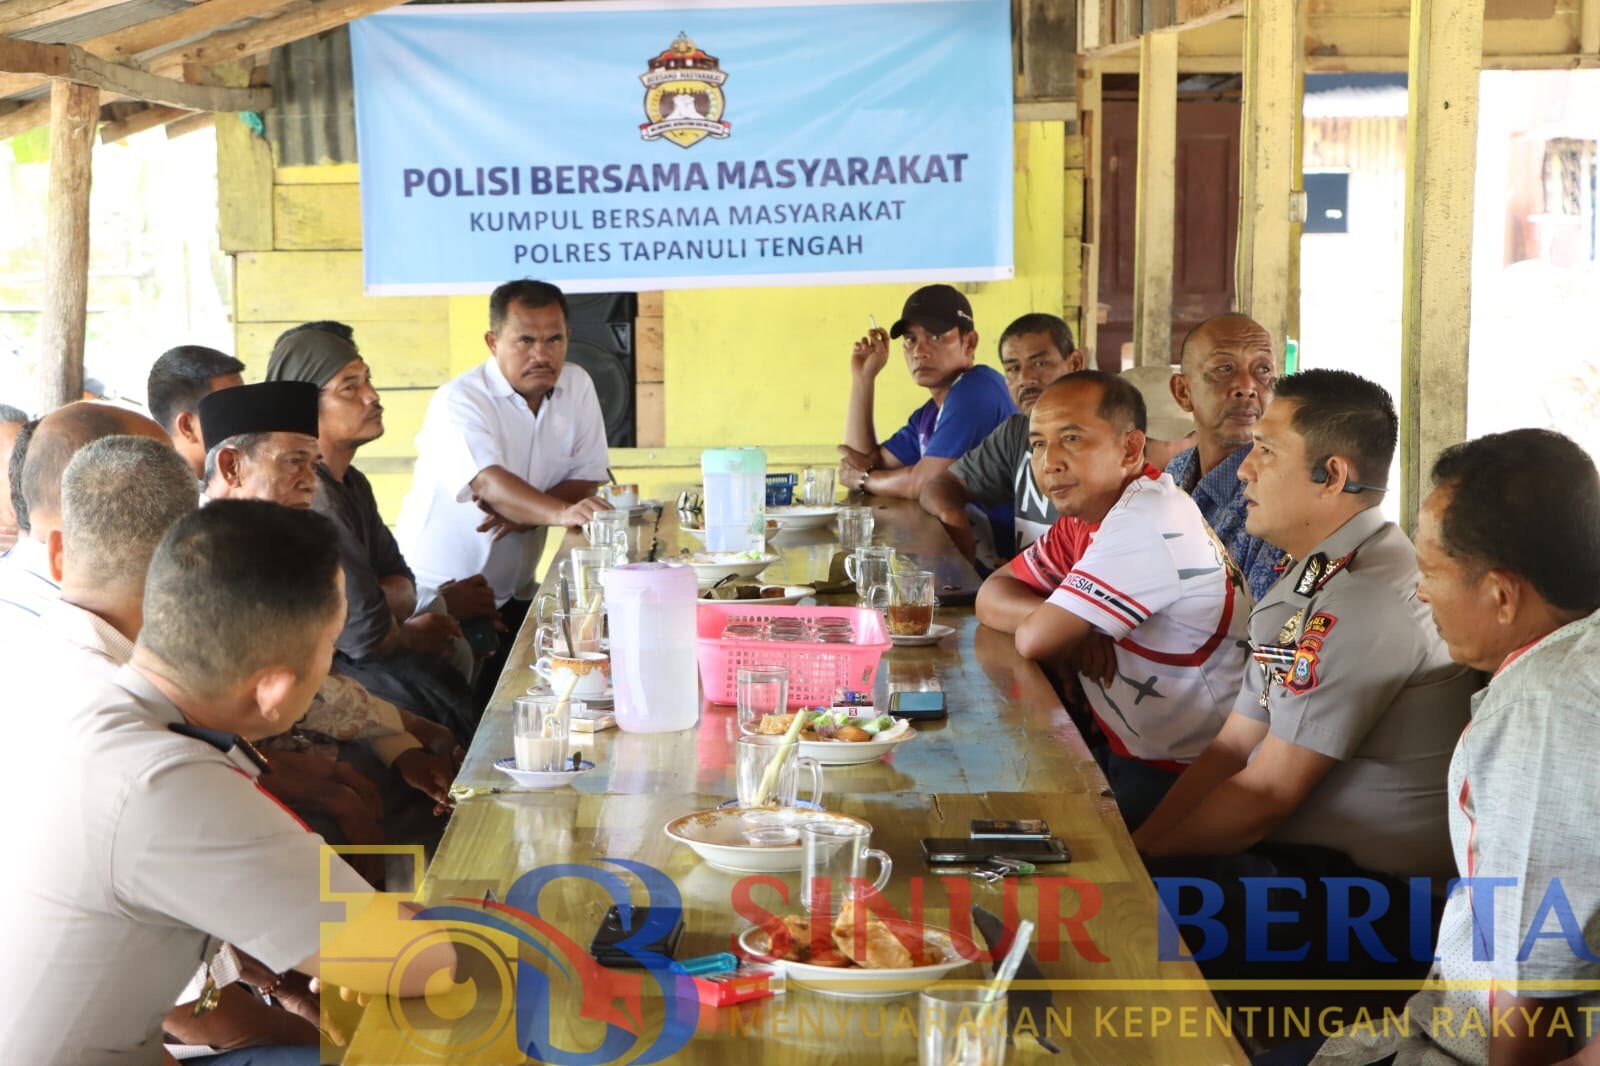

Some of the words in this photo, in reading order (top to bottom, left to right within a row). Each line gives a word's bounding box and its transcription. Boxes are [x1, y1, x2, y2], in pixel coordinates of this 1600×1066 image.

[404, 167, 520, 197] POLISI
[530, 163, 710, 195] BERSAMA
[717, 154, 969, 190] MASYARAKAT
[470, 211, 584, 232] KUMPUL
[593, 207, 720, 229] BERSAMA
[729, 200, 905, 225] MASYARAKAT
[514, 243, 611, 265] POLRES
[620, 239, 747, 262] TAPANULI
[756, 234, 863, 258] TENGAH
[1063, 573, 1094, 594] NESIA
